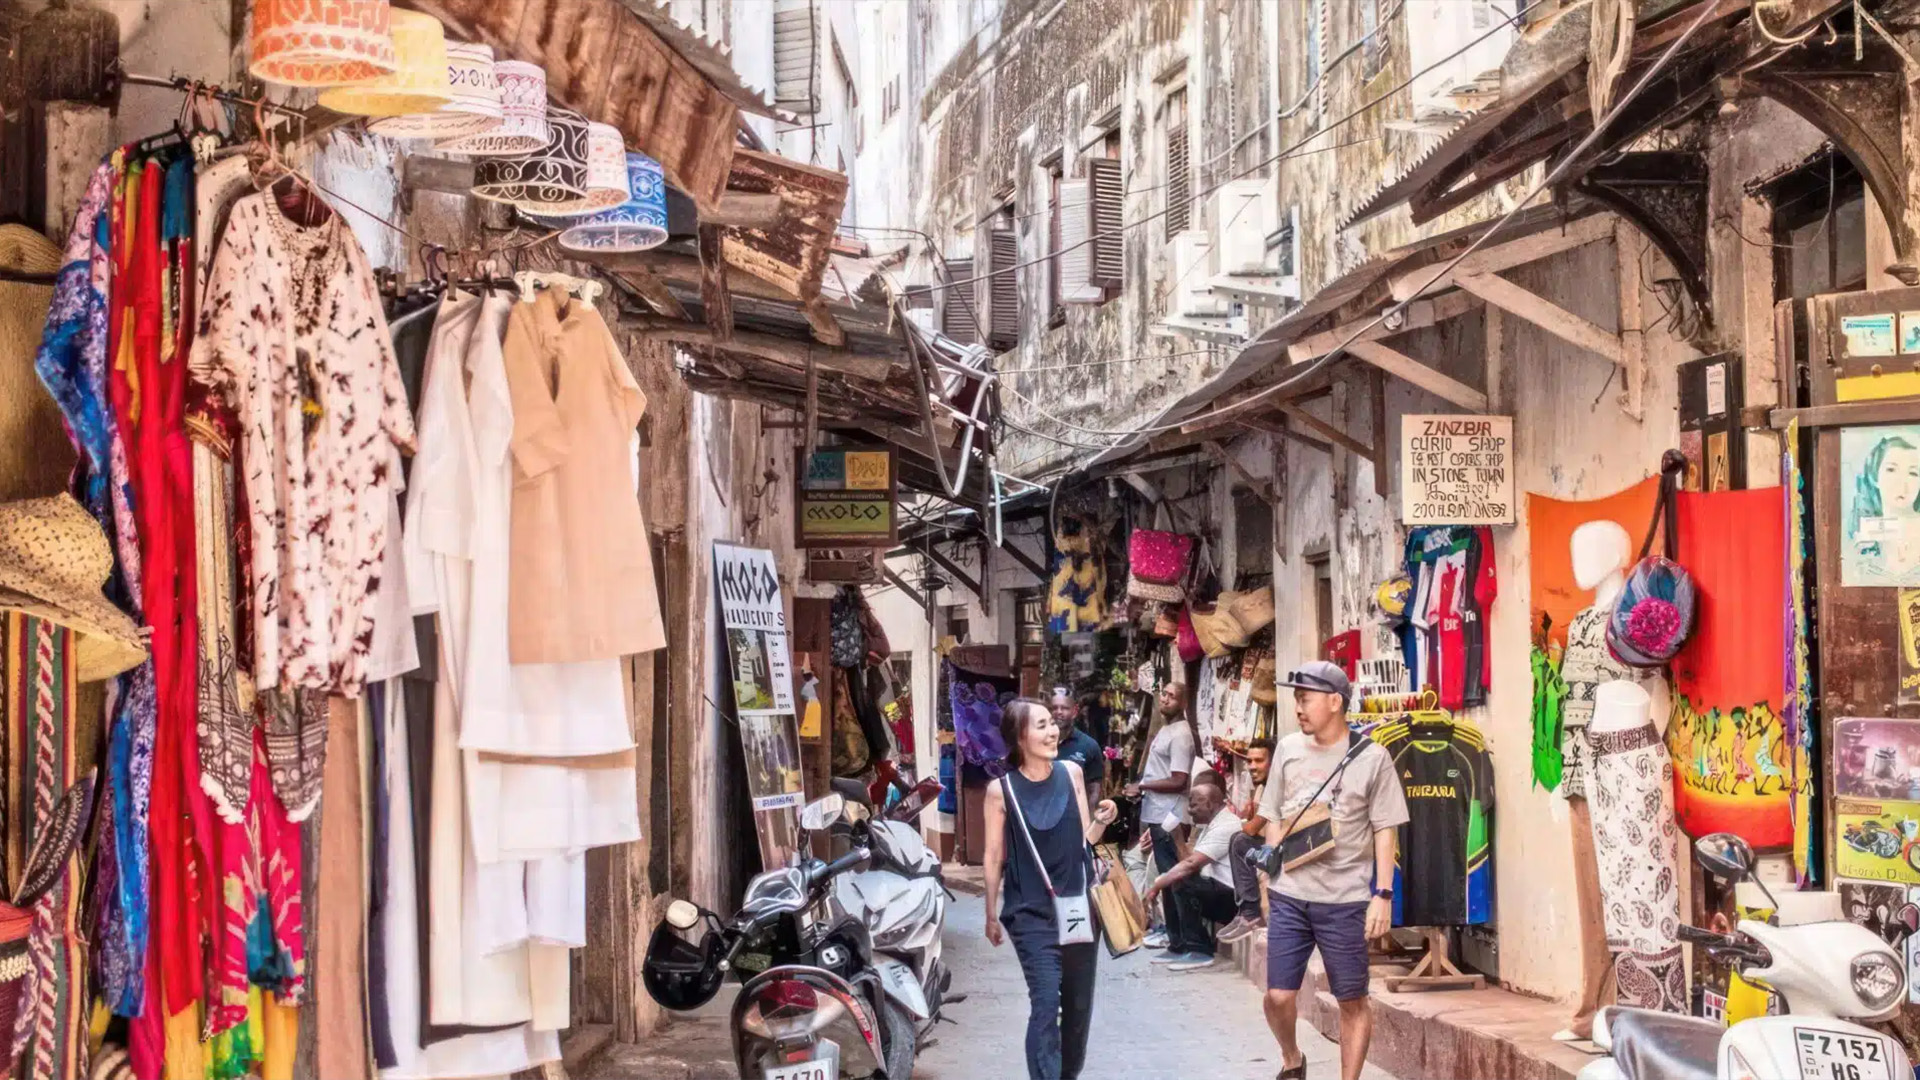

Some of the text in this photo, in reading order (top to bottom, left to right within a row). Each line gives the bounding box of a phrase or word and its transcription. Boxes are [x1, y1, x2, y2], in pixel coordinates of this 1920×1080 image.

[1410, 437, 1452, 452] CURIO
[1412, 468, 1427, 483] IN
[1837, 1038, 1881, 1062] 152
[1831, 1062, 1861, 1080] HG
